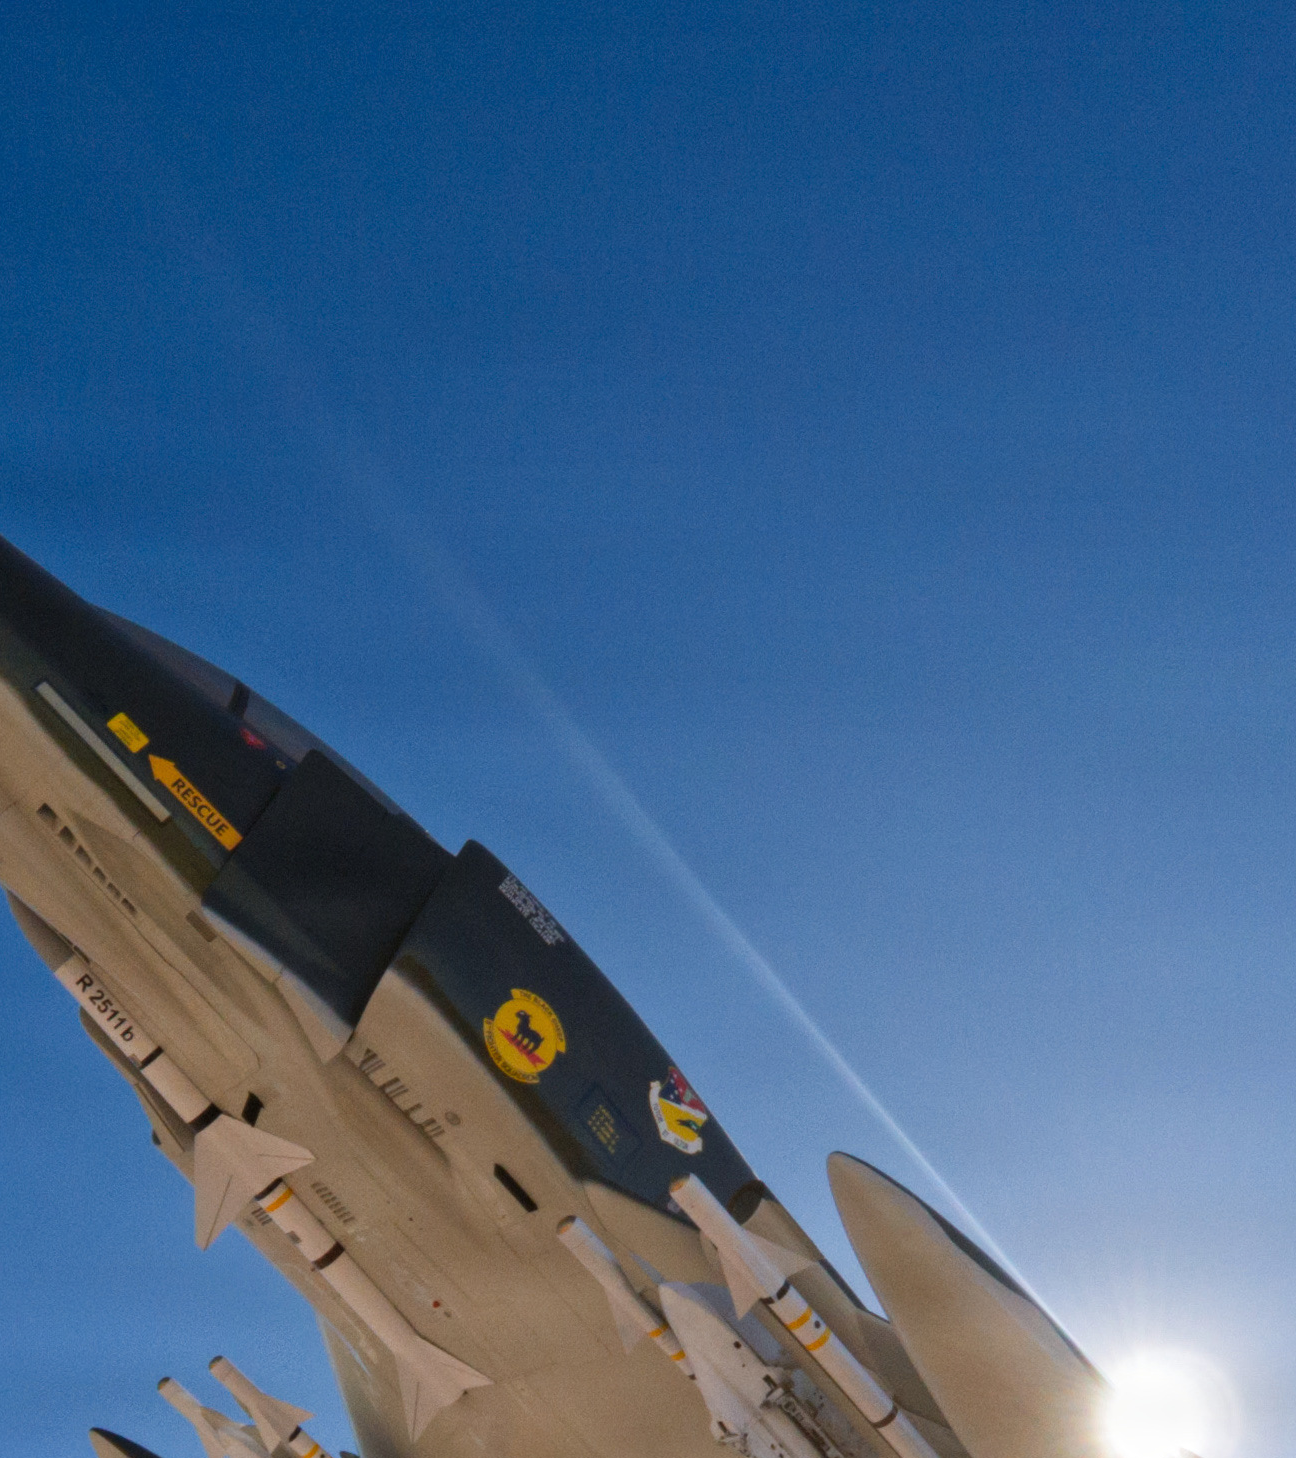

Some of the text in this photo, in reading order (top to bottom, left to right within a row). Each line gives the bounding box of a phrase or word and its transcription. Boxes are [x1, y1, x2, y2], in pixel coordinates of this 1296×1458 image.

[171, 778, 230, 837] RESCUE
[76, 973, 94, 992] R
[532, 996, 553, 1017] BLACK
